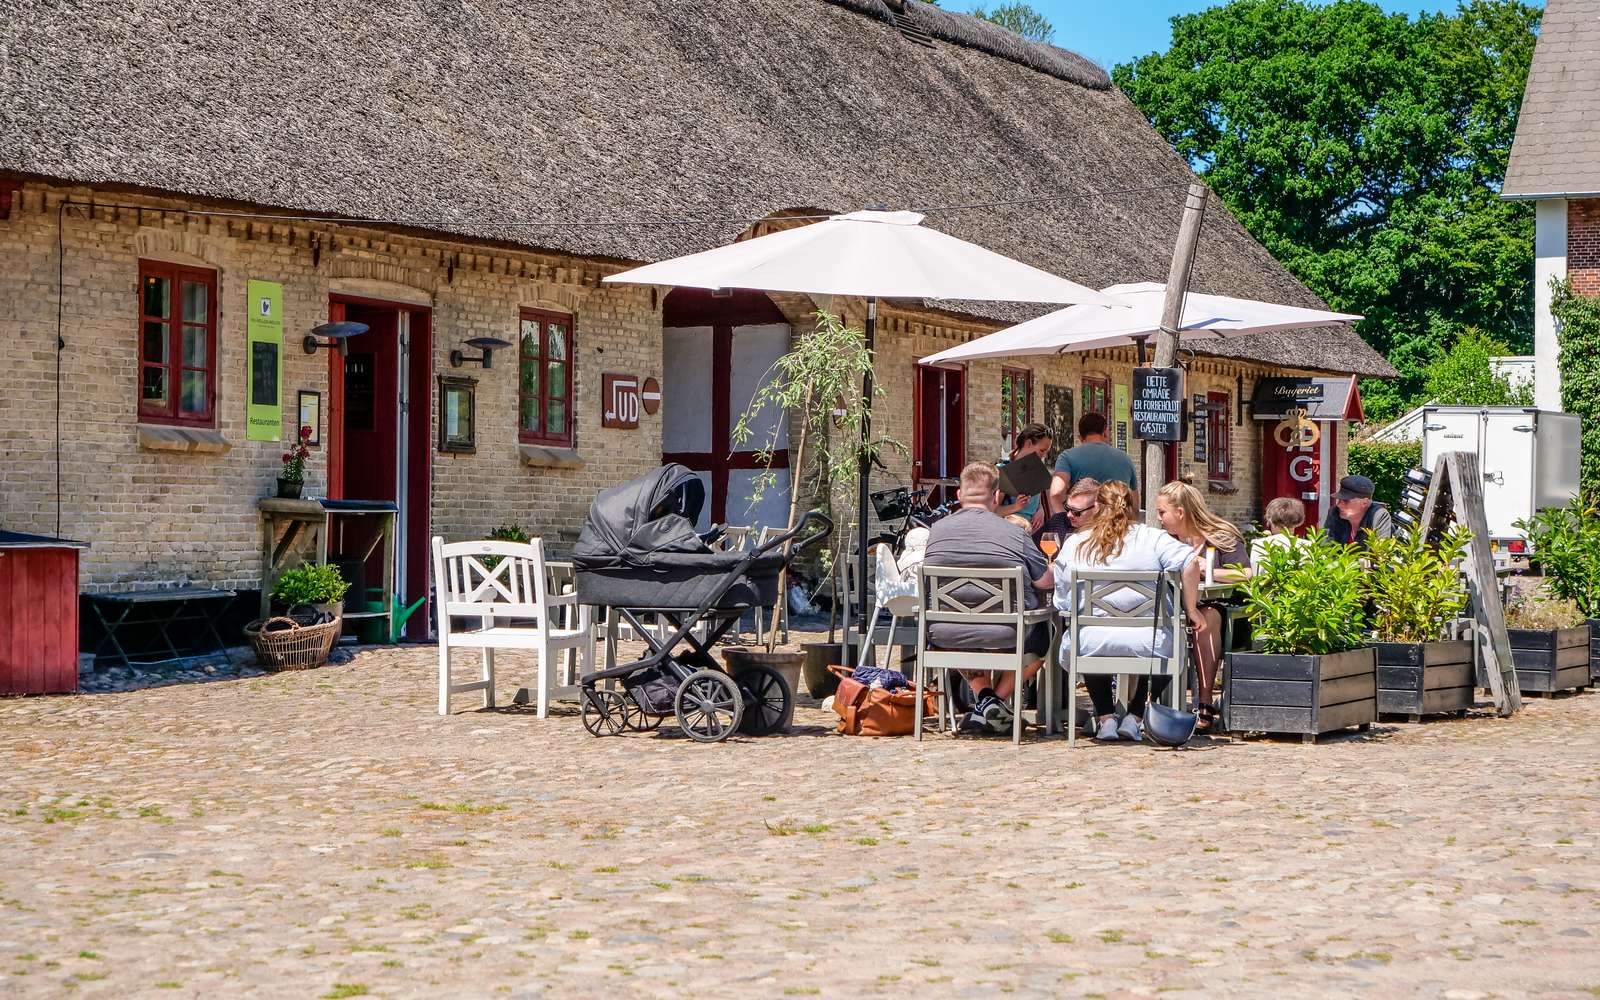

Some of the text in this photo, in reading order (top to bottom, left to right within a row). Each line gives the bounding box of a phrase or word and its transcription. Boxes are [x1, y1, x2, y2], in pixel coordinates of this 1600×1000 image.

[1146, 376, 1168, 387] DETTE
[1142, 387, 1171, 399] OMRÅDE
[1274, 386, 1320, 397] Bageriet
[1134, 400, 1180, 411] ER FORBEHOLDT
[1133, 411, 1180, 422] RESTAURANTENS
[1140, 422, 1167, 433] GÆSTER
